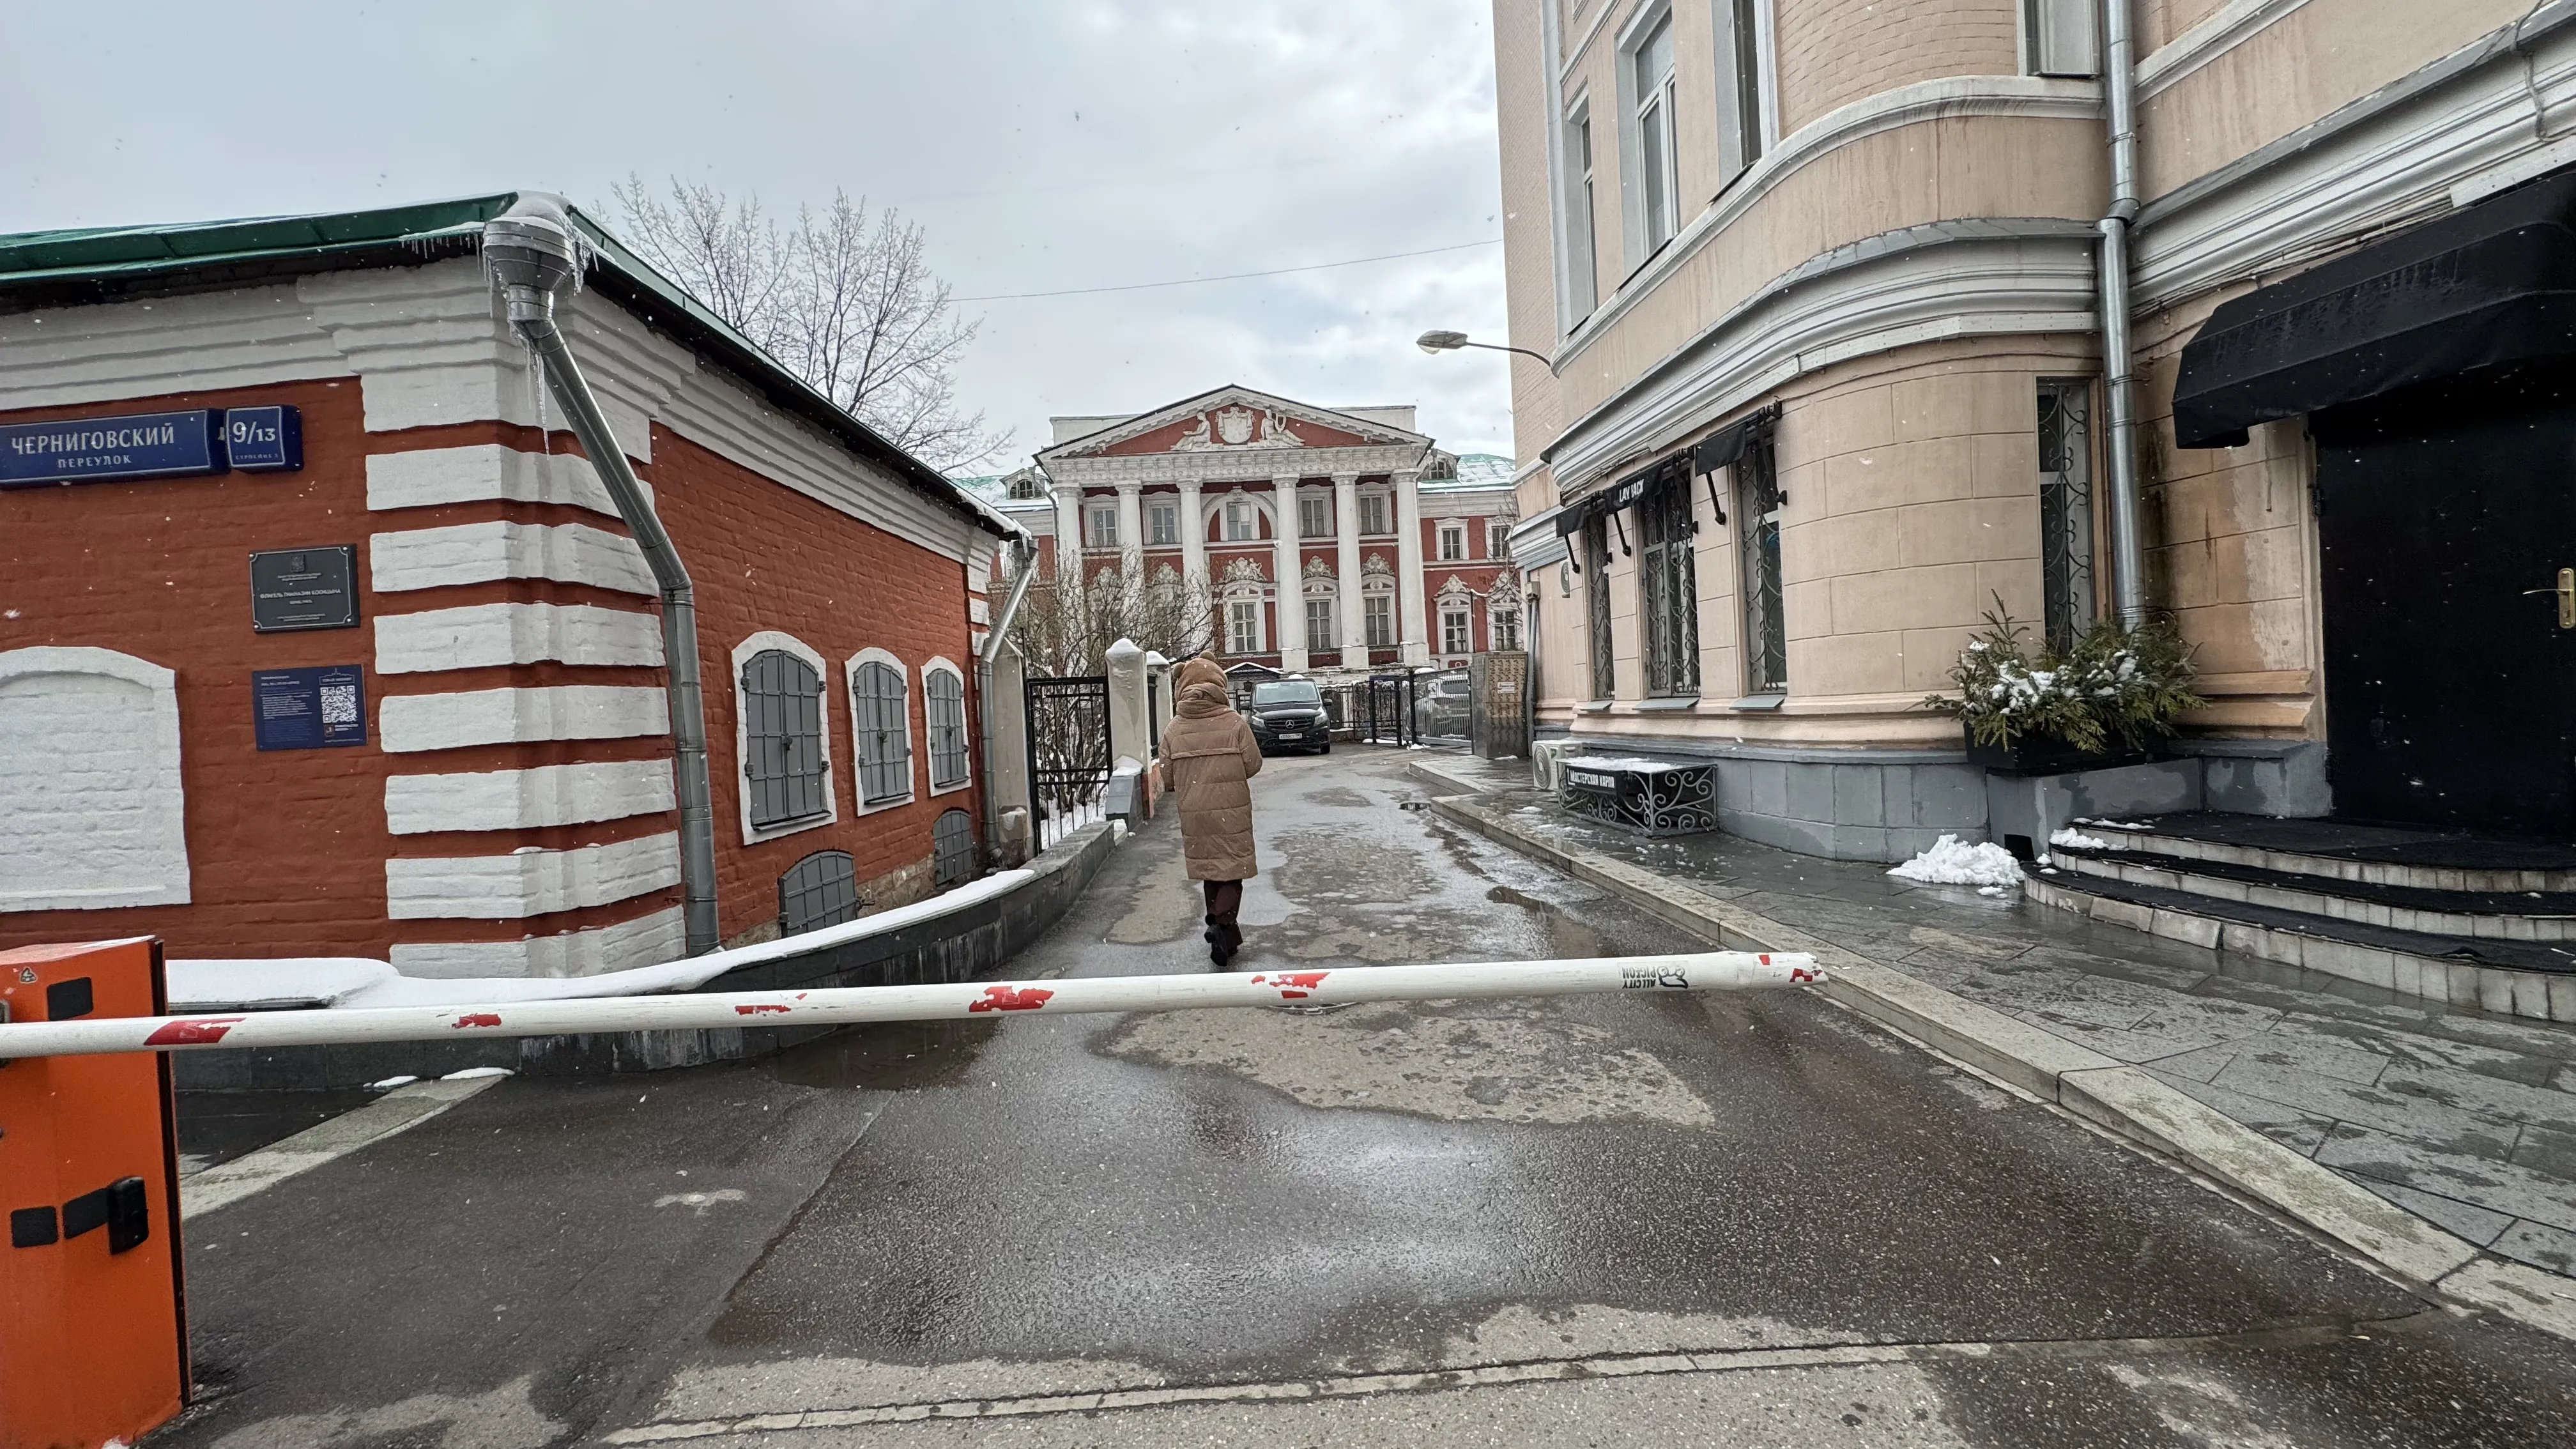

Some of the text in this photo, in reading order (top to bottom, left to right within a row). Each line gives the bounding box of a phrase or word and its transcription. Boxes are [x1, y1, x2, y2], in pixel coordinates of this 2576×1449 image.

[12, 422, 174, 455] ЧЕРНИГОВСКИЙ
[233, 421, 276, 444] 9/13
[57, 455, 132, 468] ПЕРЕУЛОК
[1619, 486, 1630, 503] LAY
